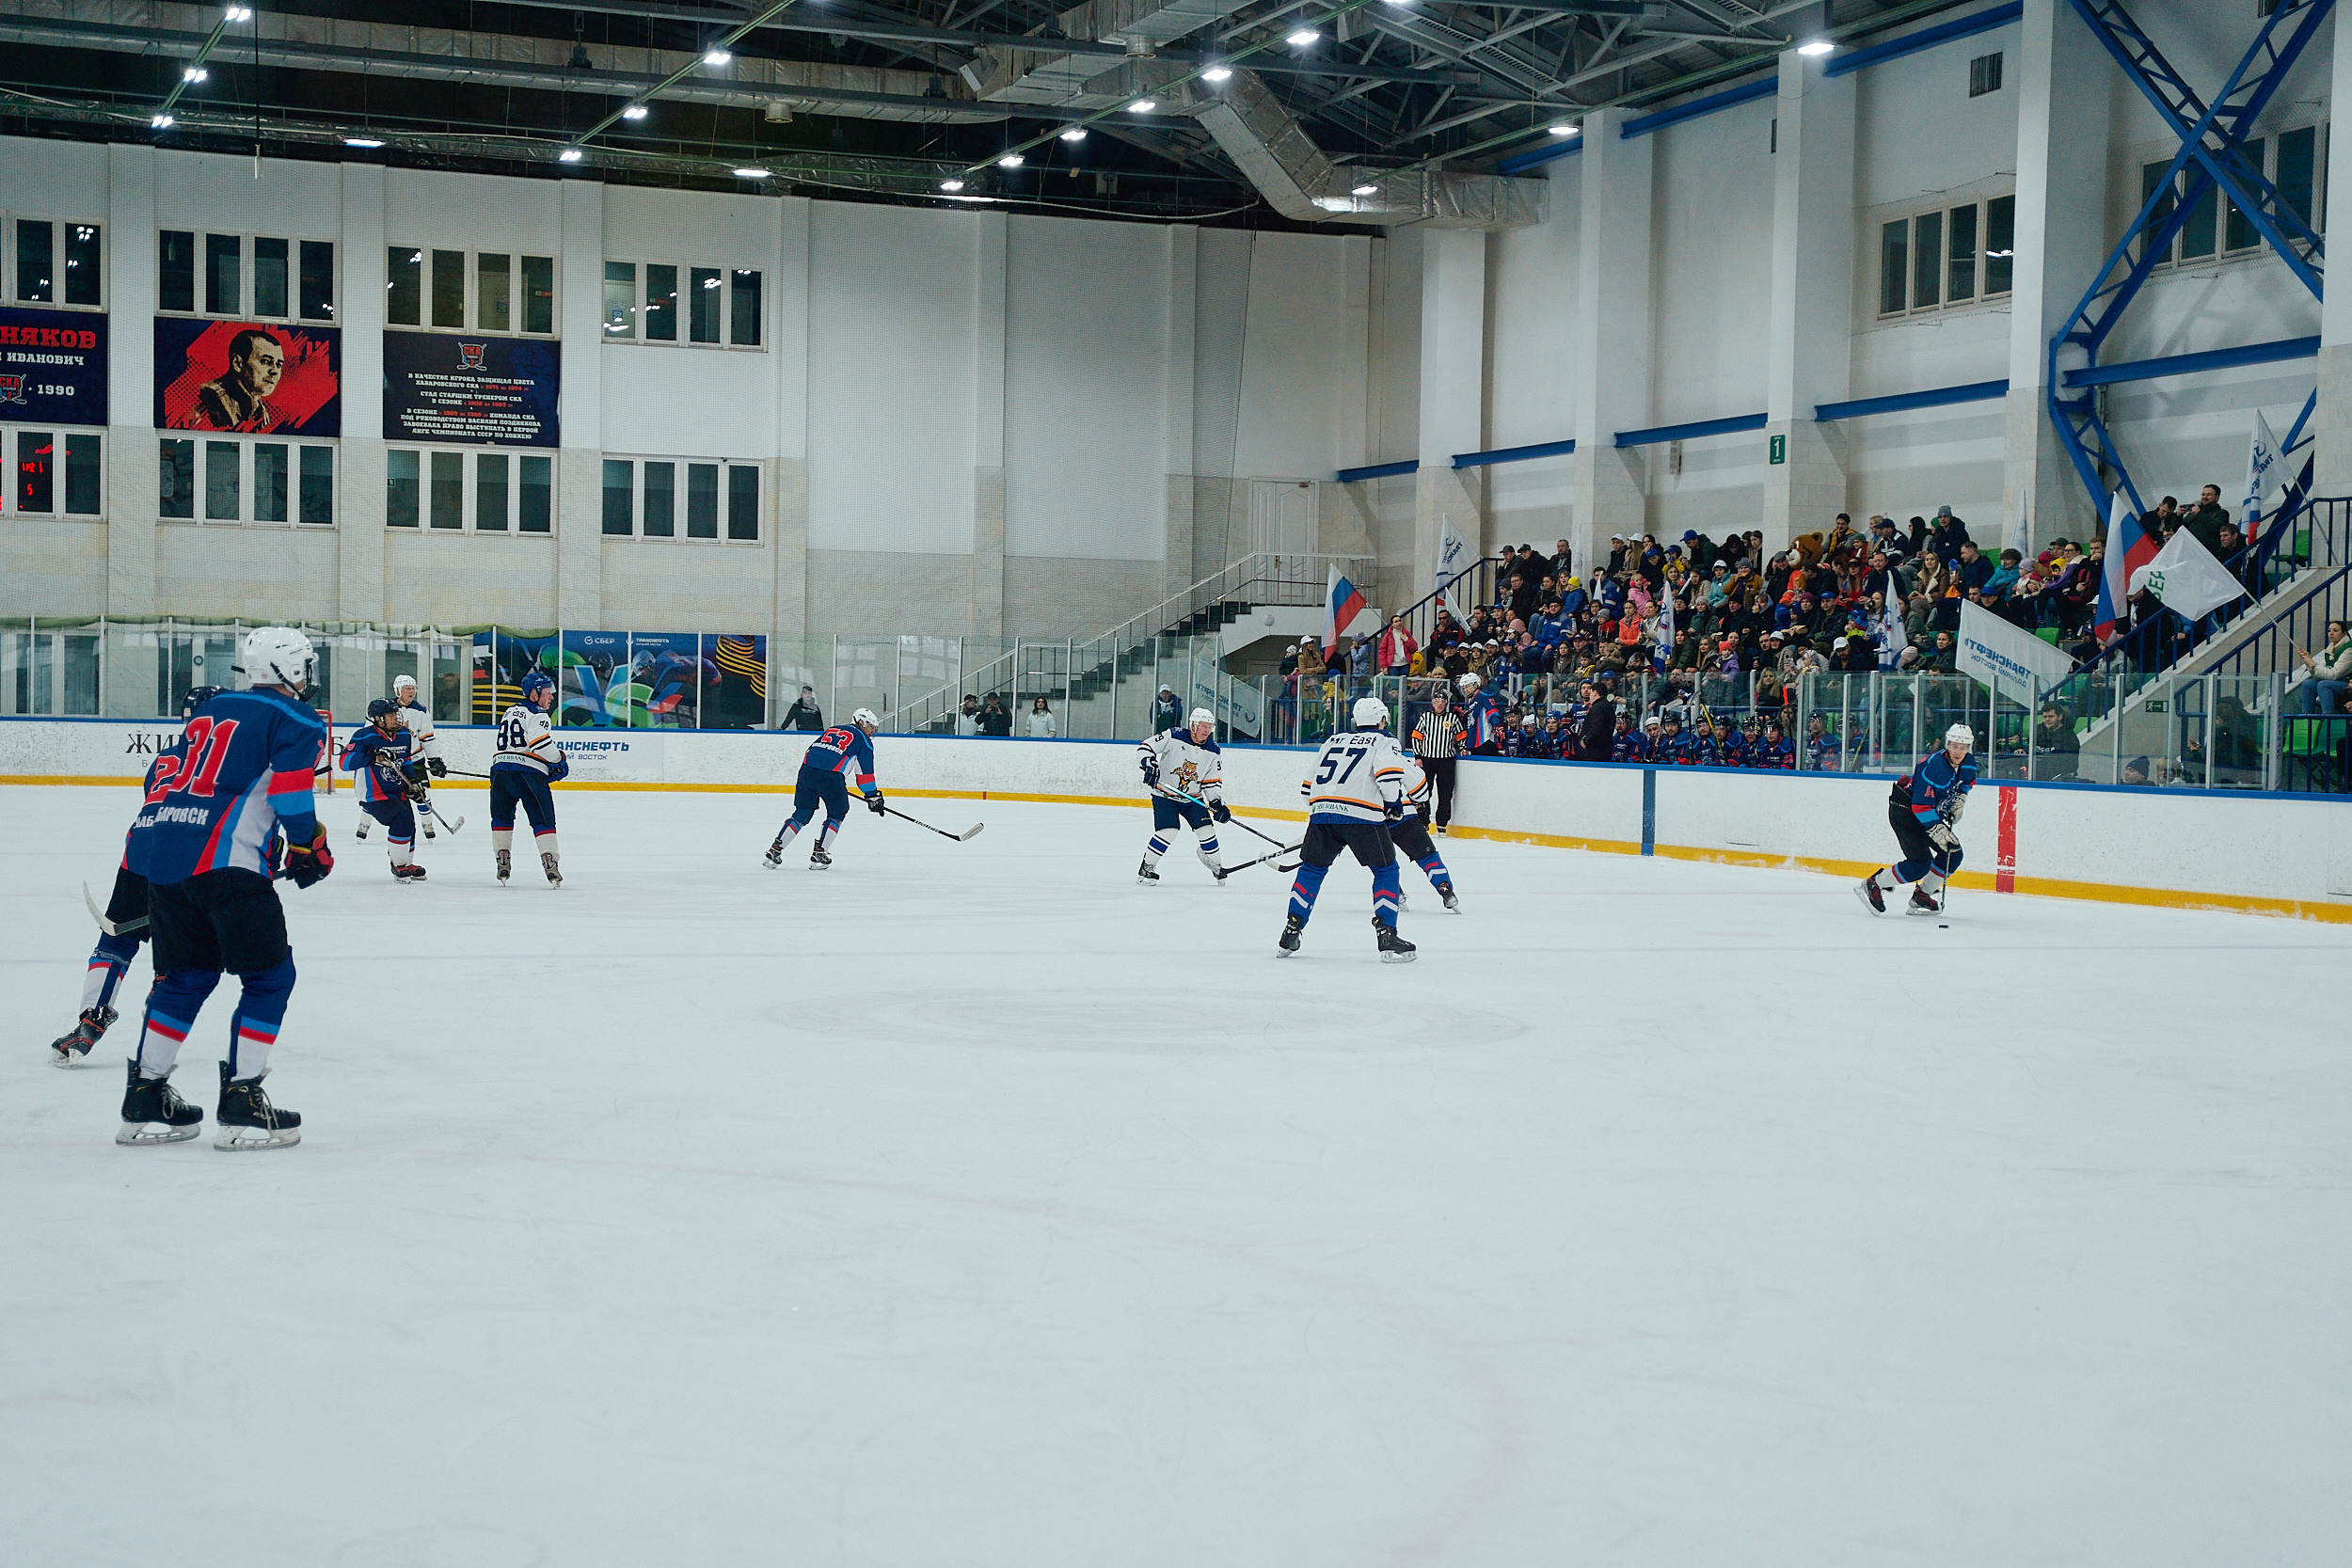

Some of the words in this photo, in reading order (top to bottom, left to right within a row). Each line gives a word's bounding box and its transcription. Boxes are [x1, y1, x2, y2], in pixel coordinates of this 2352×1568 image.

[0, 325, 96, 349] НЯКОВ
[464, 346, 481, 356] СКА
[7, 352, 84, 365] ИВАНОВИЧ
[38, 384, 74, 396] 1990
[1774, 440, 1779, 457] 1
[497, 719, 527, 751] 88
[1350, 736, 1377, 746] East
[553, 741, 629, 752] АНСНЕФТЬ
[1316, 748, 1368, 784] 57
